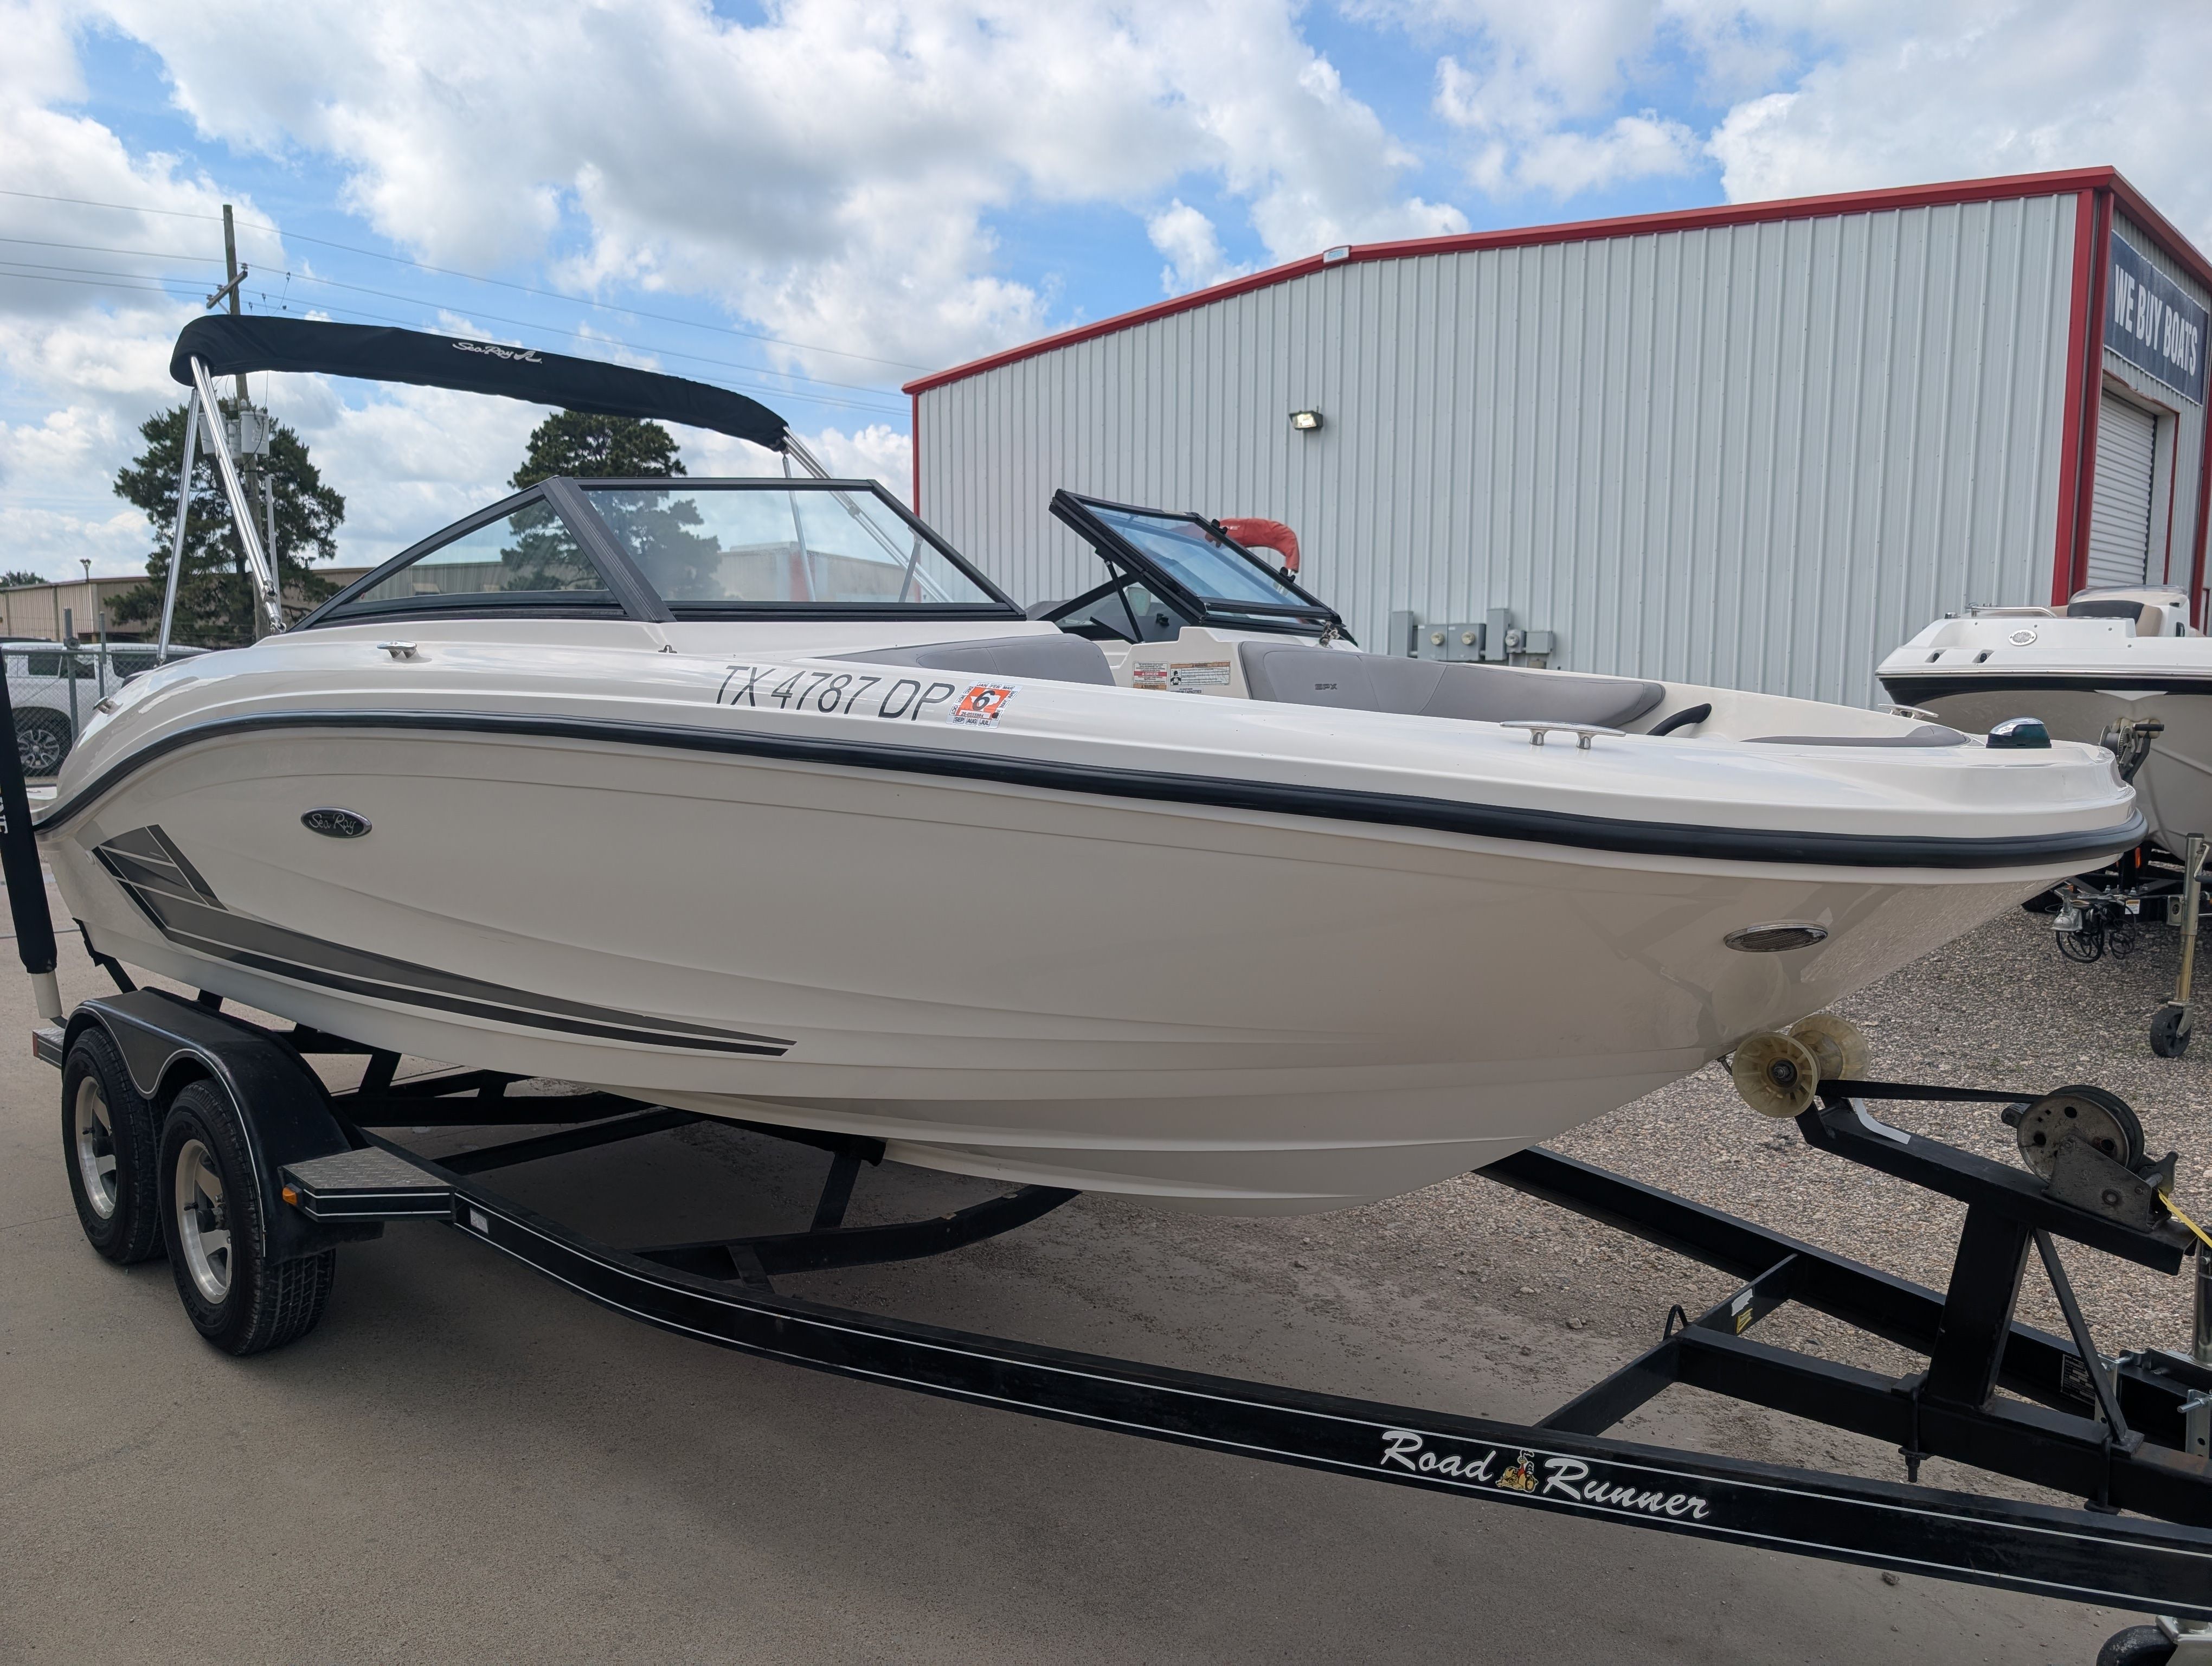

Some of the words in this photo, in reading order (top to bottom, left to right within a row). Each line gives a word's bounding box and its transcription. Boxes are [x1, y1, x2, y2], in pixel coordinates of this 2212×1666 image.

[2114, 264, 2135, 333] WE
[2136, 284, 2162, 351] BUY
[2163, 305, 2198, 377] BOATS
[452, 342, 486, 354] Sea
[484, 345, 515, 359] Ray
[716, 665, 776, 707] TX
[770, 670, 881, 715] 4787
[878, 678, 956, 722] DP
[972, 690, 995, 711] 6
[308, 813, 331, 830] Sea
[332, 812, 357, 835] Ray
[1379, 1430, 1496, 1482] Road
[1541, 1457, 1711, 1520] Runner
